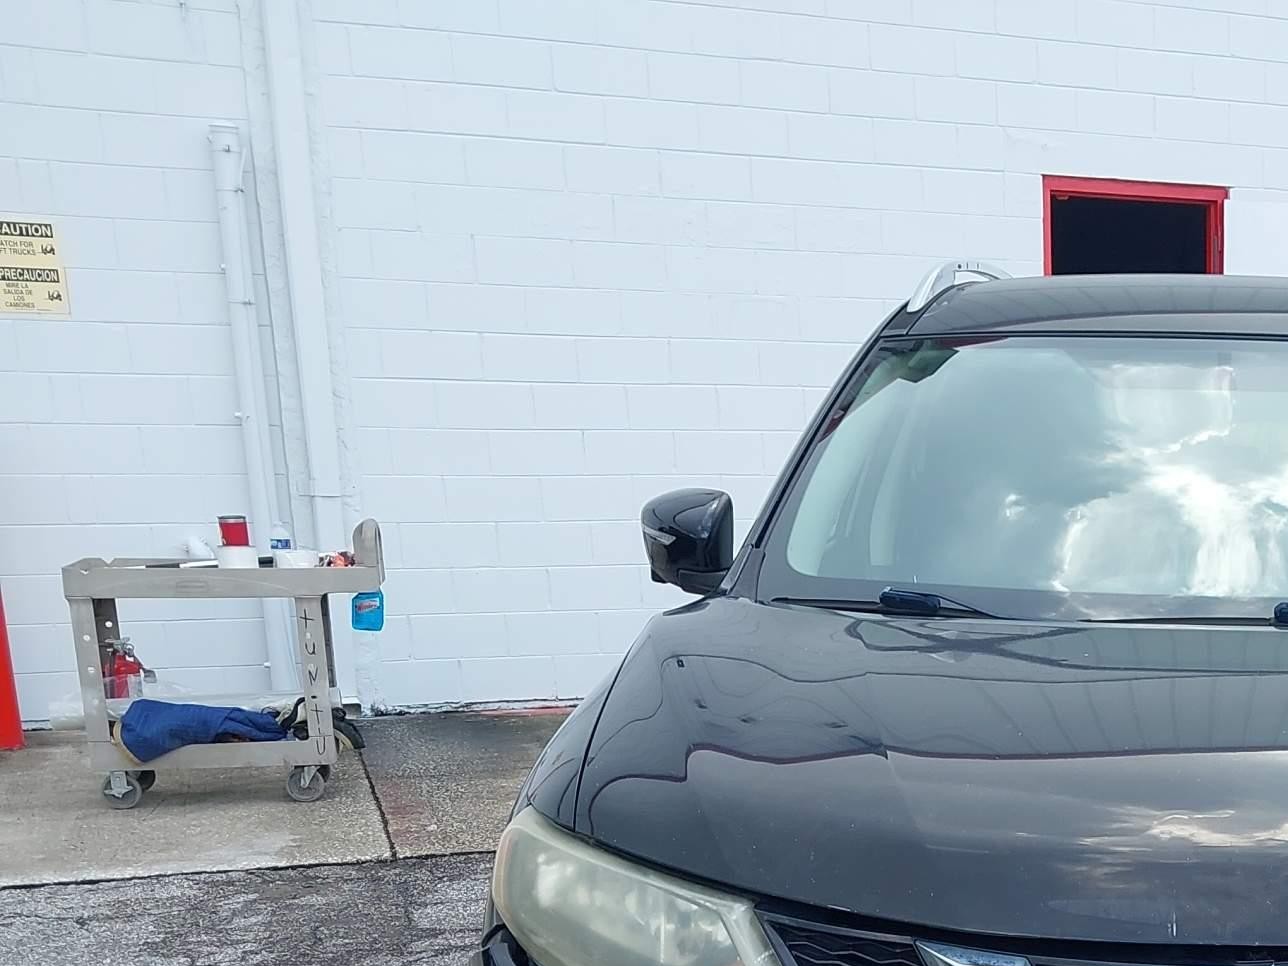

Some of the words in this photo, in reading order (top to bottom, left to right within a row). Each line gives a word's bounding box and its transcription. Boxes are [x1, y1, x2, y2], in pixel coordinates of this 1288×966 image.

[0, 222, 51, 236] AUTION
[0, 239, 18, 248] ATCH
[20, 241, 34, 249] FOR
[10, 247, 36, 256] TRUCKS
[0, 268, 57, 281] PRECAUCION
